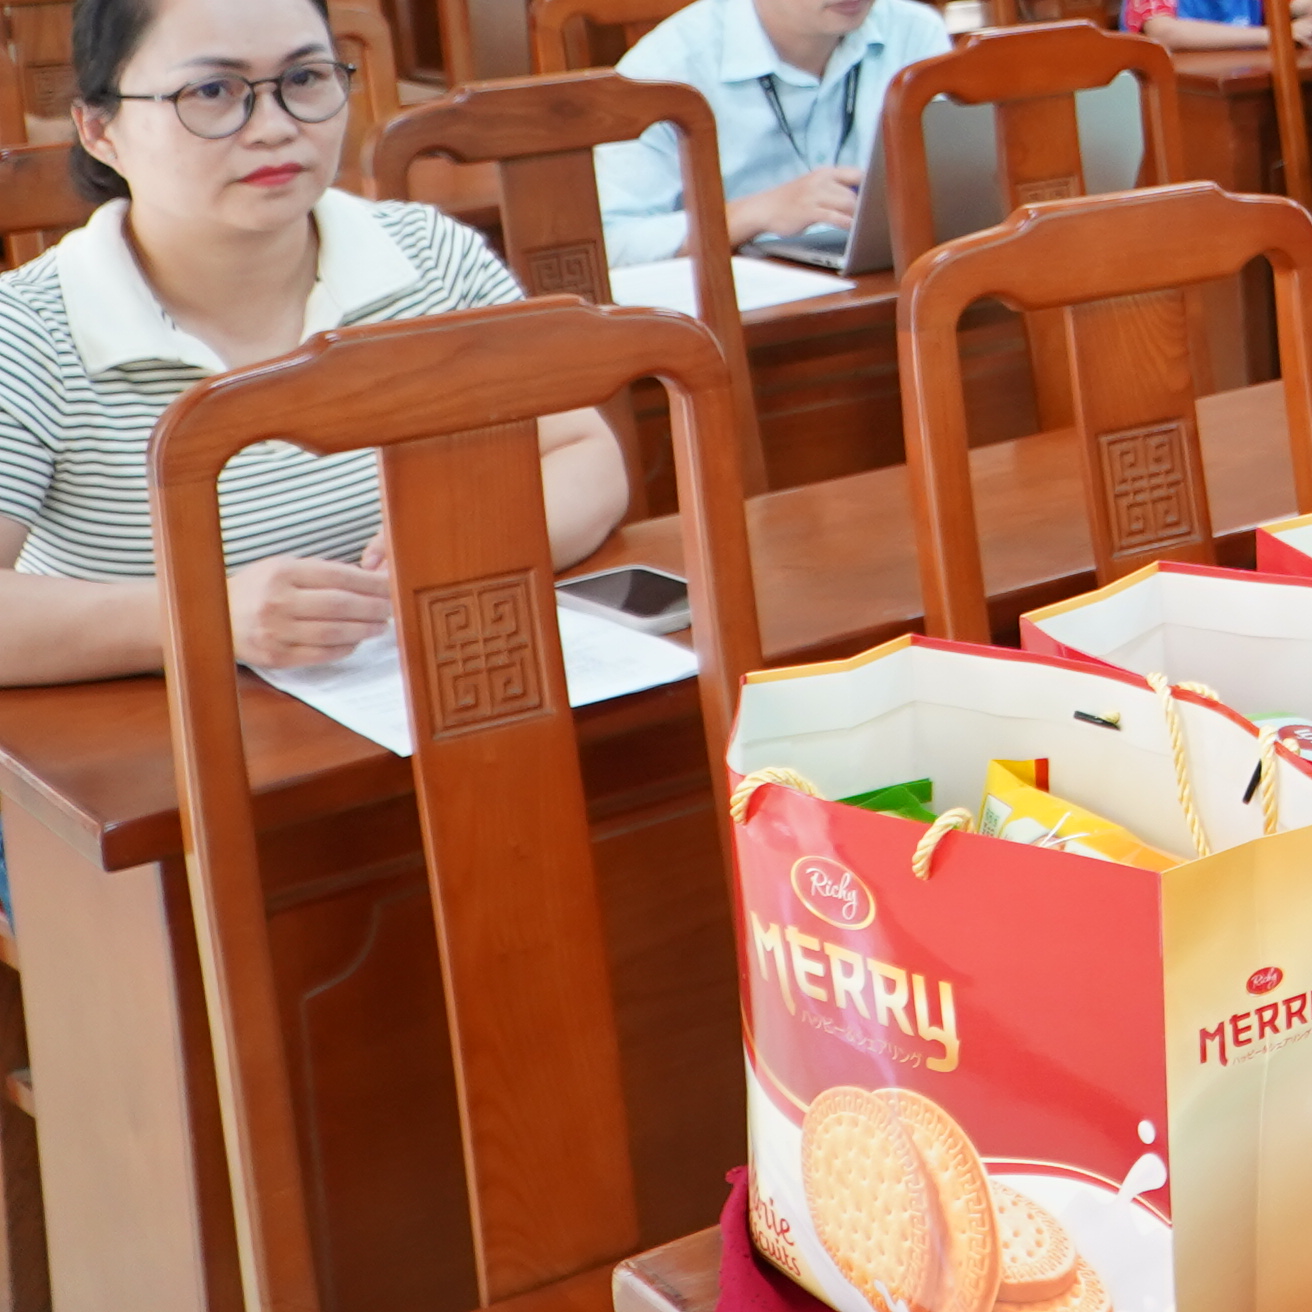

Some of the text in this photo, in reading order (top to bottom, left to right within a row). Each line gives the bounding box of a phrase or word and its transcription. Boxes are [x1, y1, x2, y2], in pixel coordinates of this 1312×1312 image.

[805, 867, 858, 920] Richy
[750, 910, 960, 1073] MERRY
[1250, 966, 1279, 989] Richy
